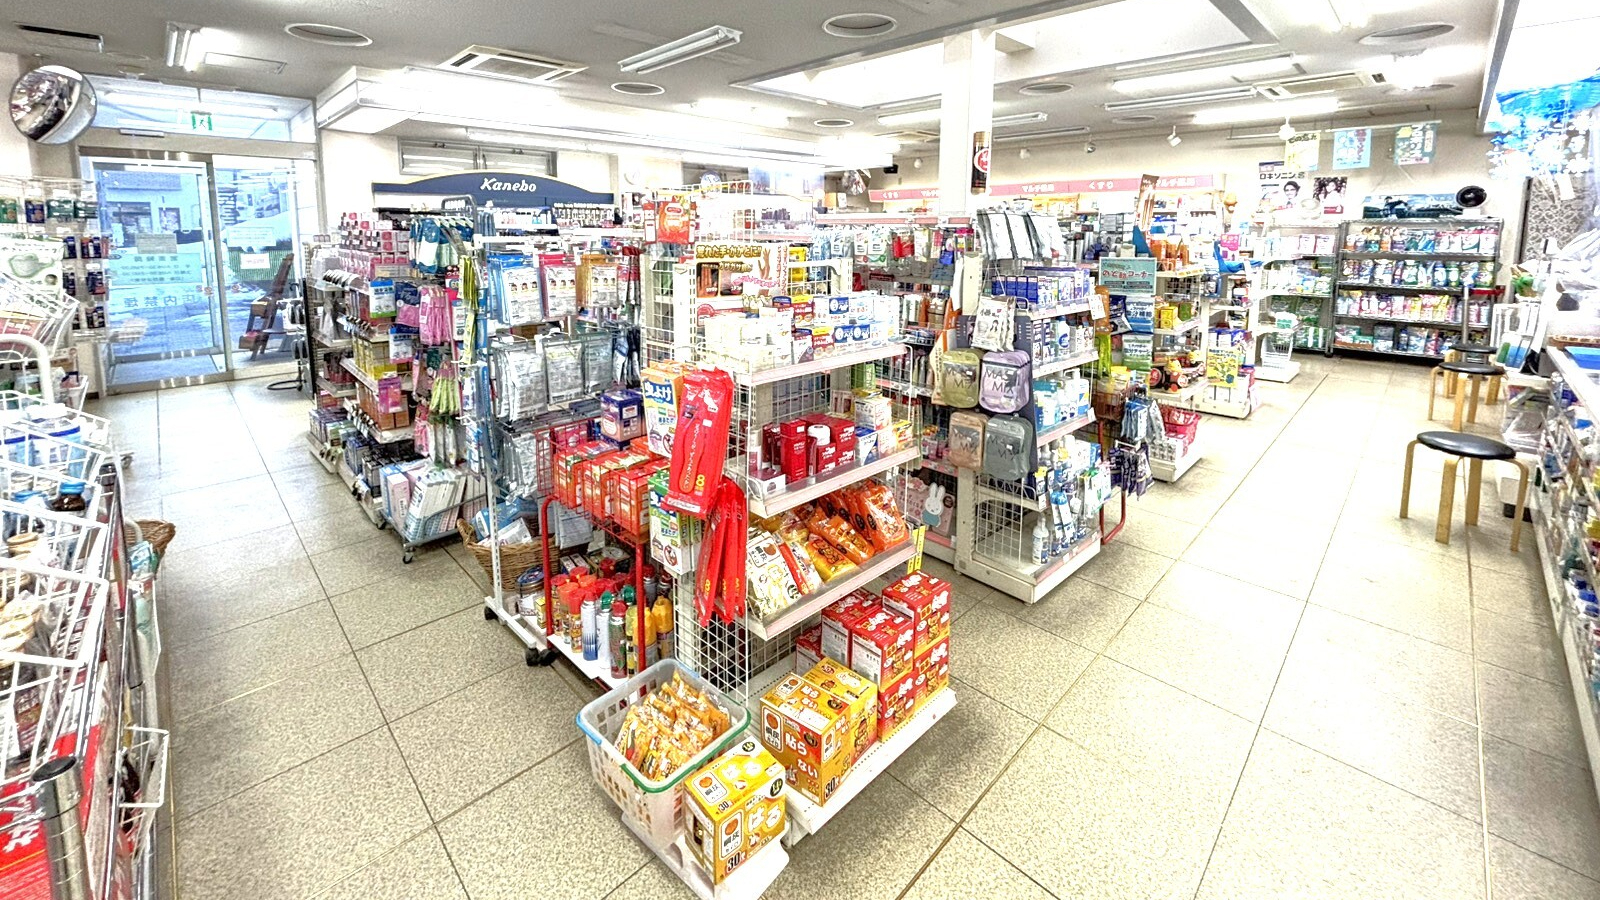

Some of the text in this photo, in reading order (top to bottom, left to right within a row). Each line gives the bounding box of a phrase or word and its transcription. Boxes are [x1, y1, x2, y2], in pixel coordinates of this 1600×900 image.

[480, 177, 537, 192] Kanebo
[644, 380, 672, 402] 虫よけ
[696, 474, 705, 487] 8
[785, 732, 807, 756] 貼ら
[797, 758, 818, 779] ない
[747, 805, 782, 834] はる
